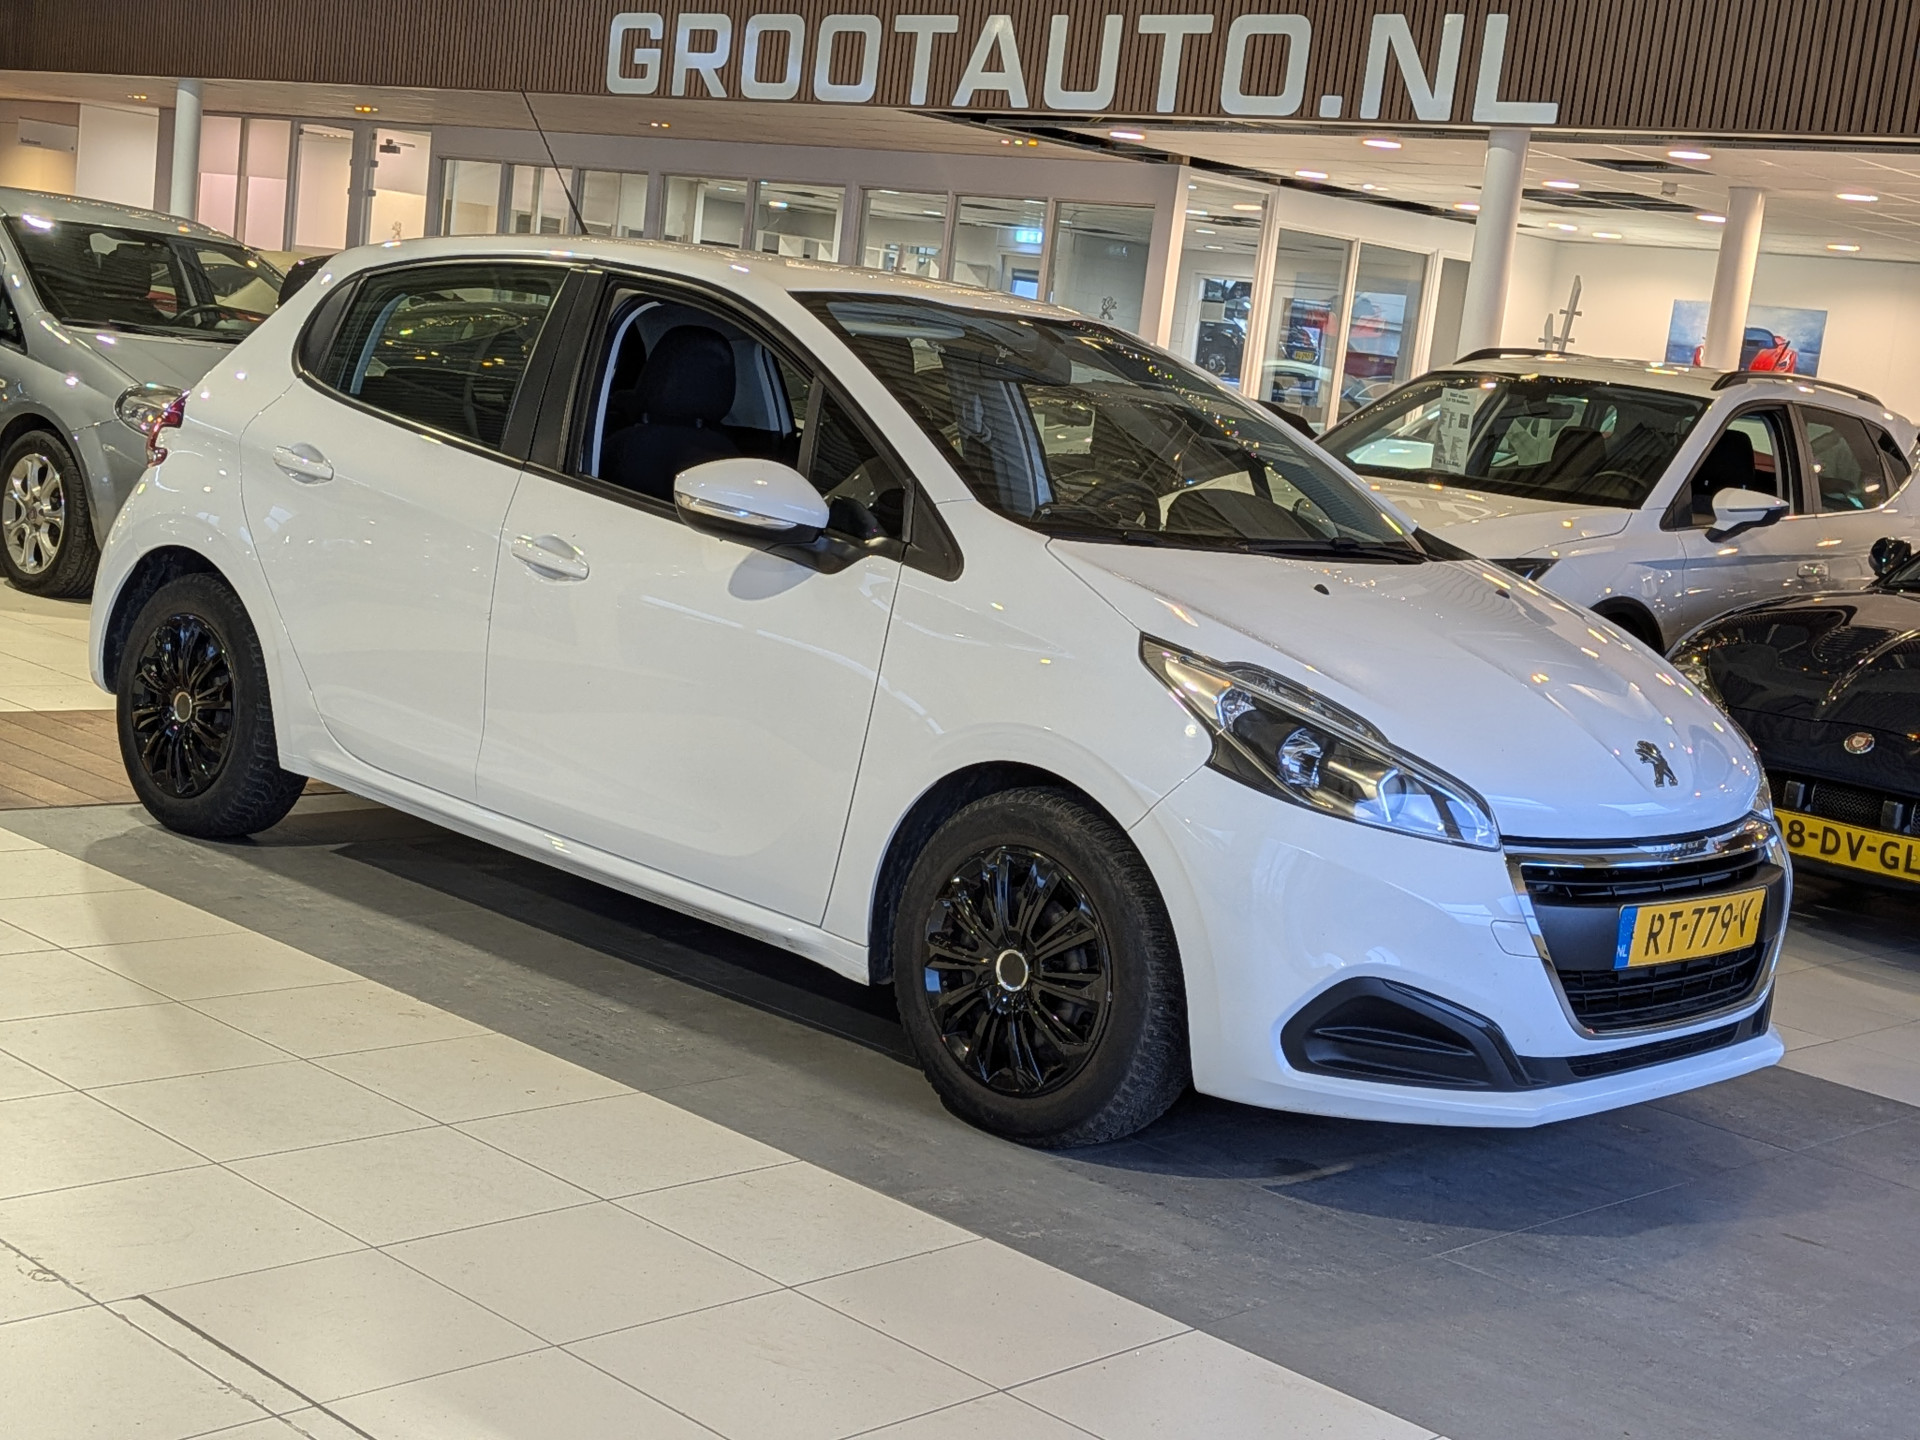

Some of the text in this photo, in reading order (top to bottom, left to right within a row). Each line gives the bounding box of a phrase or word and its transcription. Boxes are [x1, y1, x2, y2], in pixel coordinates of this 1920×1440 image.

[605, 12, 1559, 125] GROOTAUTO.NL
[1616, 944, 1628, 957] NL
[1644, 897, 1755, 957] RT-779-V
